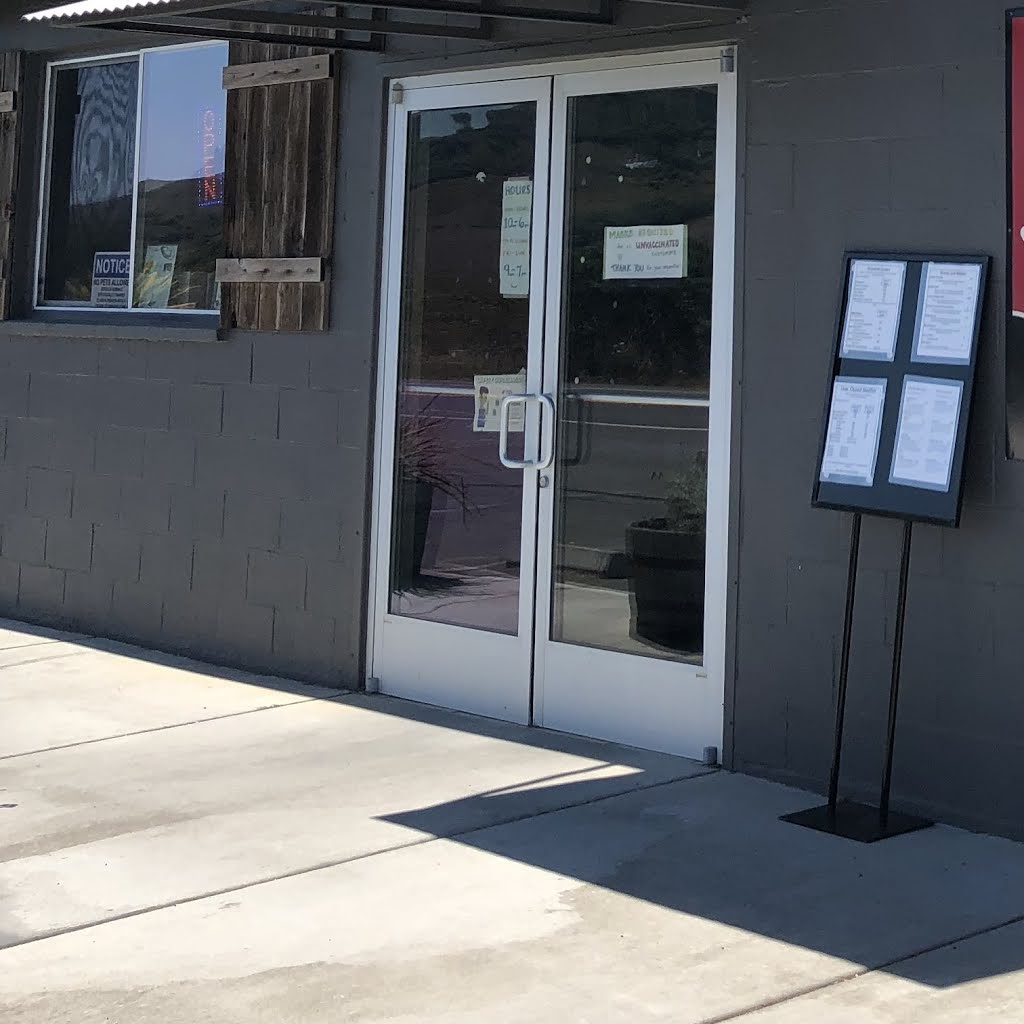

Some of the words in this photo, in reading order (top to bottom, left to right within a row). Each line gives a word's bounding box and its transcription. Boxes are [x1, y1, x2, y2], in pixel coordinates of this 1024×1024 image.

[505, 185, 531, 196] HOURS
[96, 258, 130, 274] NOTICE
[611, 264, 631, 272] THANK
[634, 264, 645, 272] YOU
